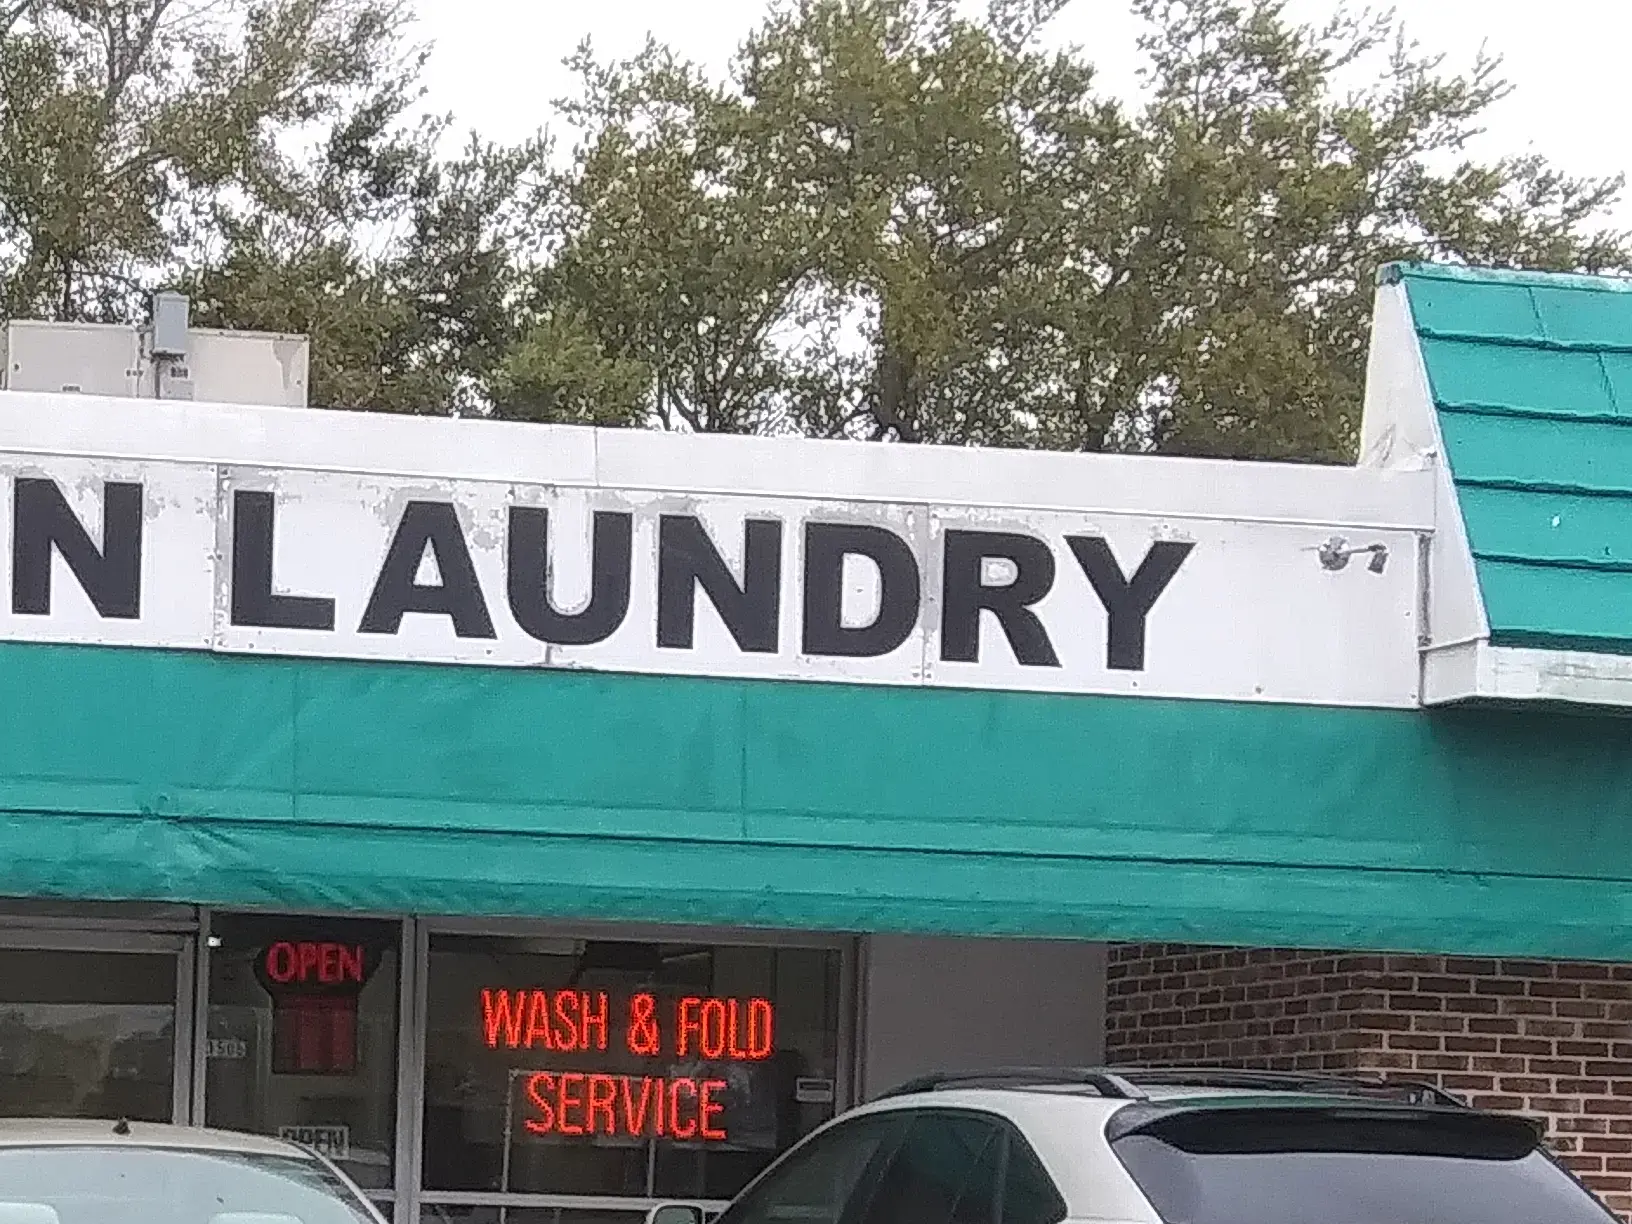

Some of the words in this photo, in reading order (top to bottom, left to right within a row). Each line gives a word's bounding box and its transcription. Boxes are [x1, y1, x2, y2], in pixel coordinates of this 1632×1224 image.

[229, 489, 1196, 671] LAUNDRY
[266, 941, 364, 982] OPEN
[481, 987, 609, 1051] WASH
[627, 992, 660, 1056] &
[676, 996, 776, 1061] FOLD
[524, 1071, 728, 1141] SERVICE
